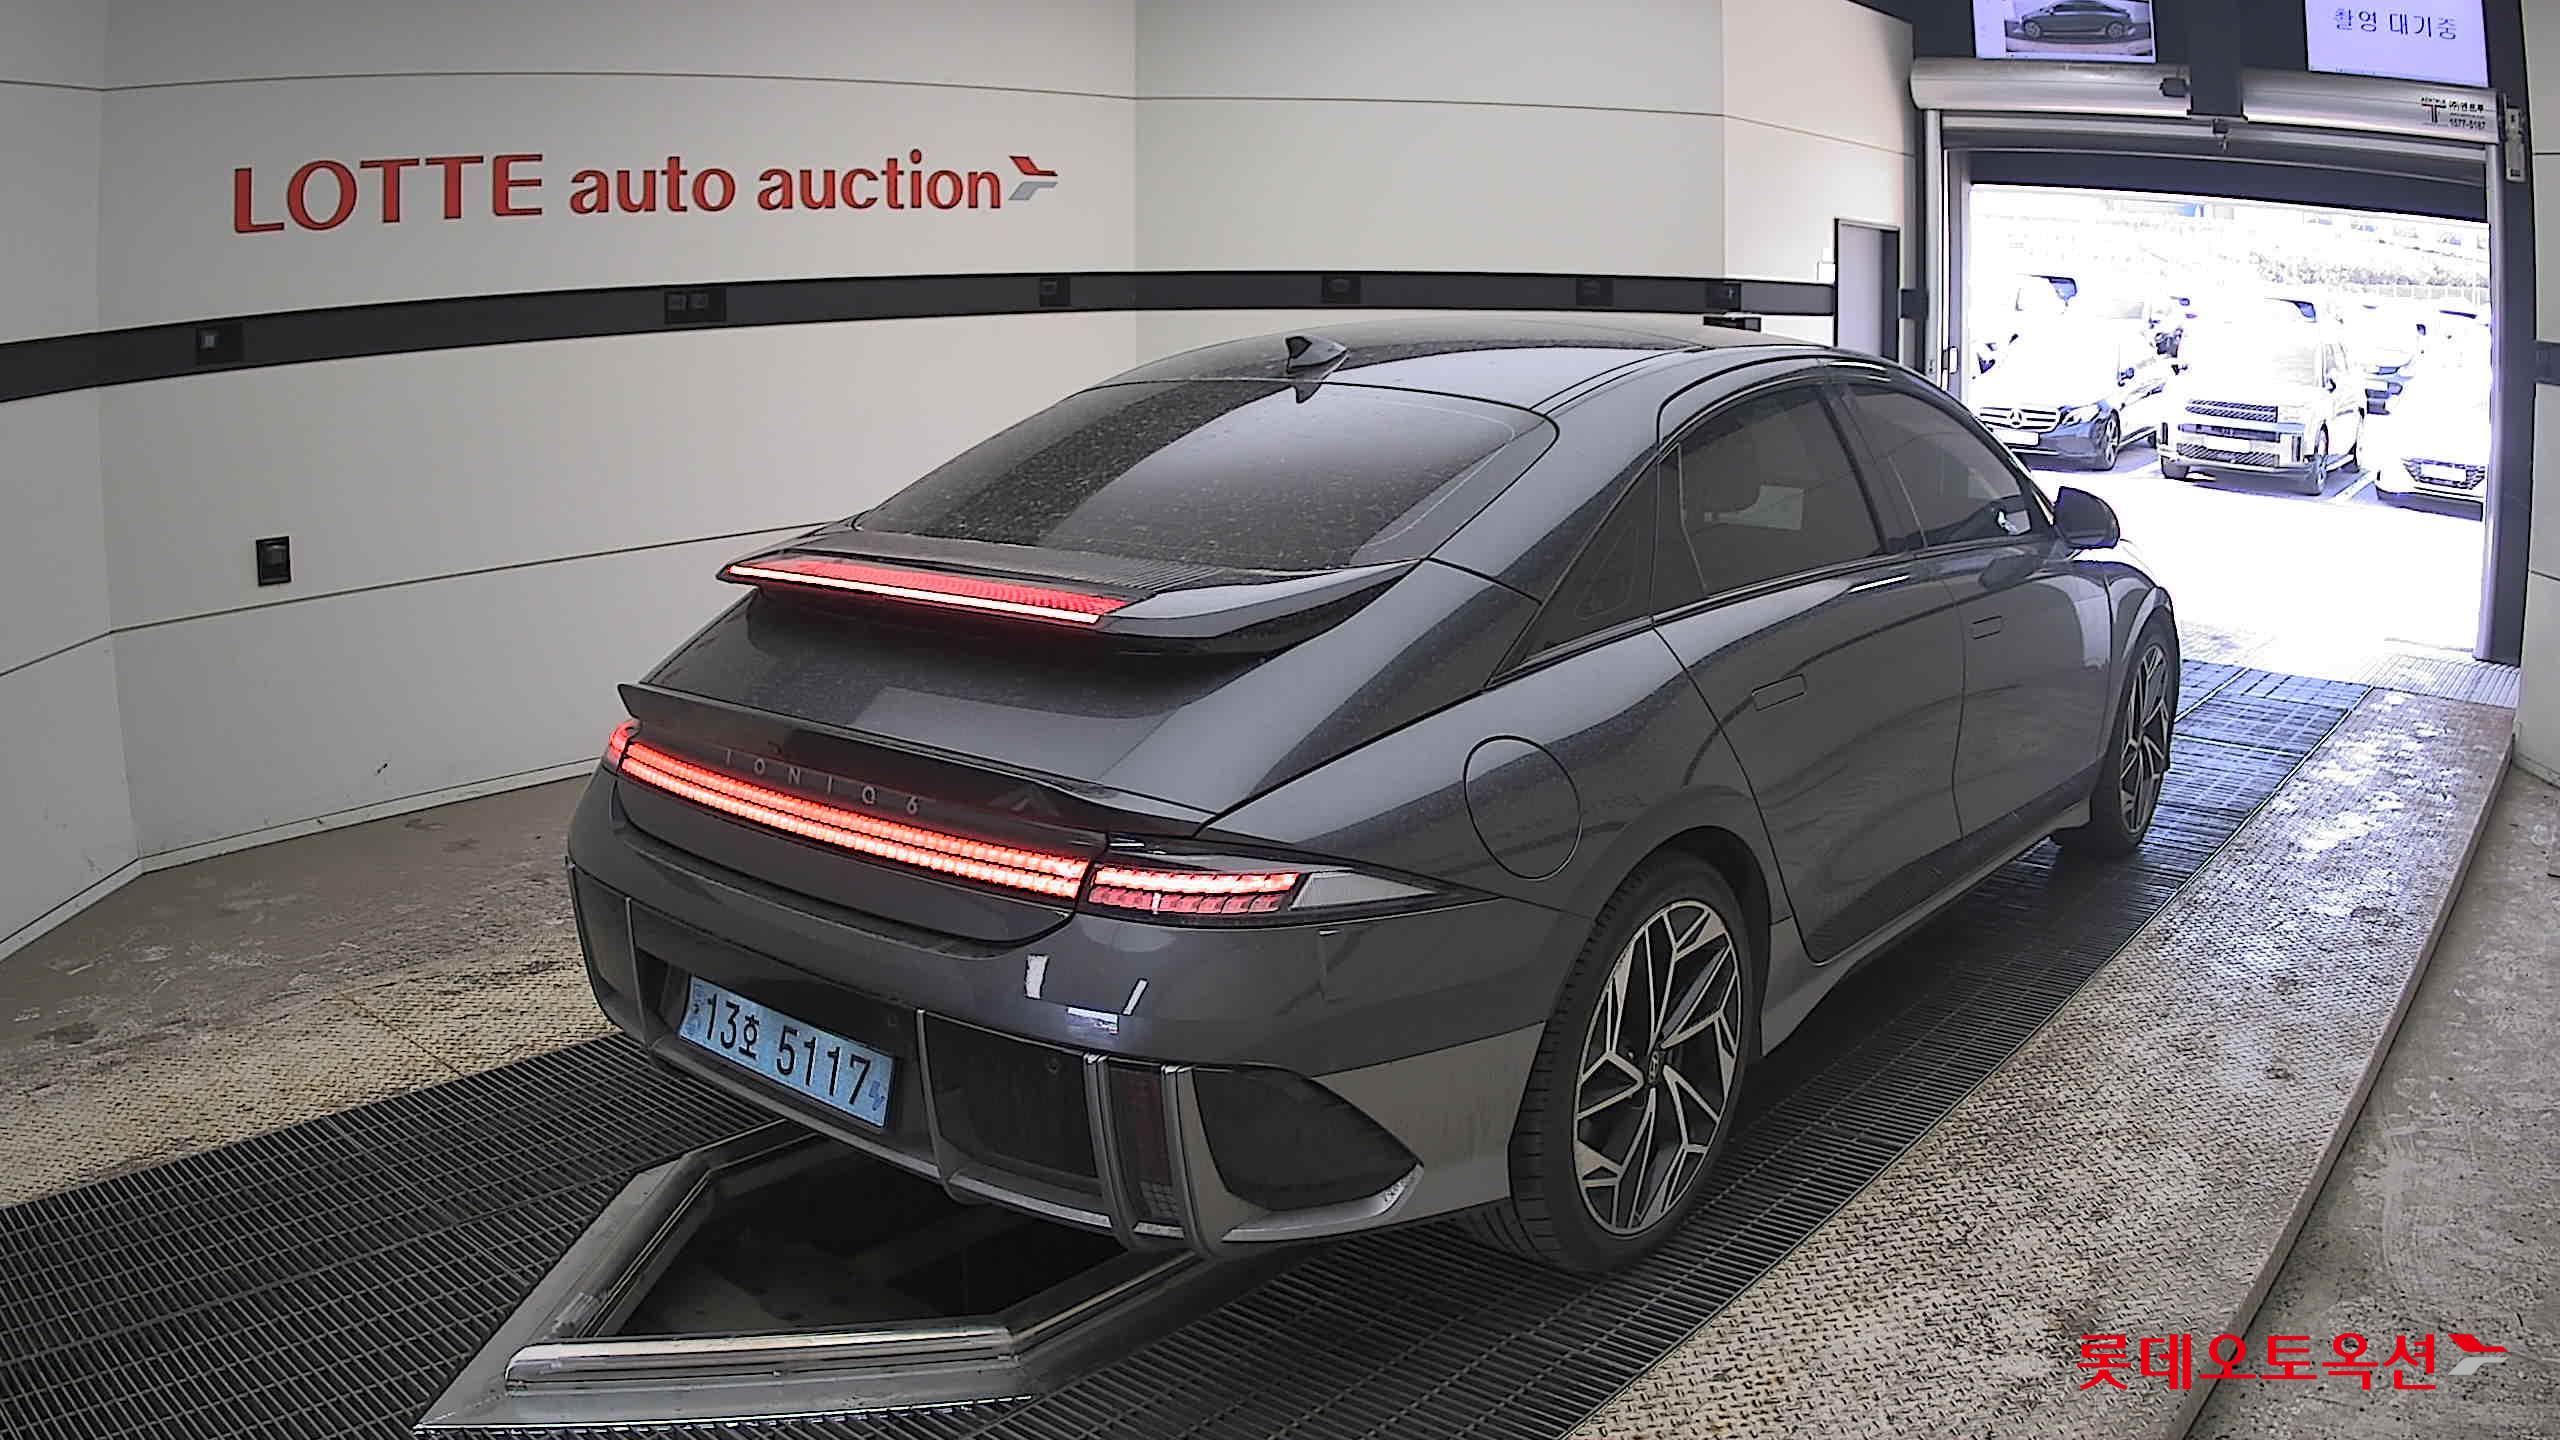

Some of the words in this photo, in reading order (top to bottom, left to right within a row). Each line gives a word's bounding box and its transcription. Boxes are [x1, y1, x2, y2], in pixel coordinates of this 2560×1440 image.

[2335, 9, 2377, 33] 촬영
[2389, 13, 2457, 40] 대기중
[234, 153, 544, 234] LOTTE
[569, 155, 737, 215] auto
[757, 148, 1002, 210] auction
[706, 993, 761, 1060] 13호
[776, 1023, 872, 1106] 5117
